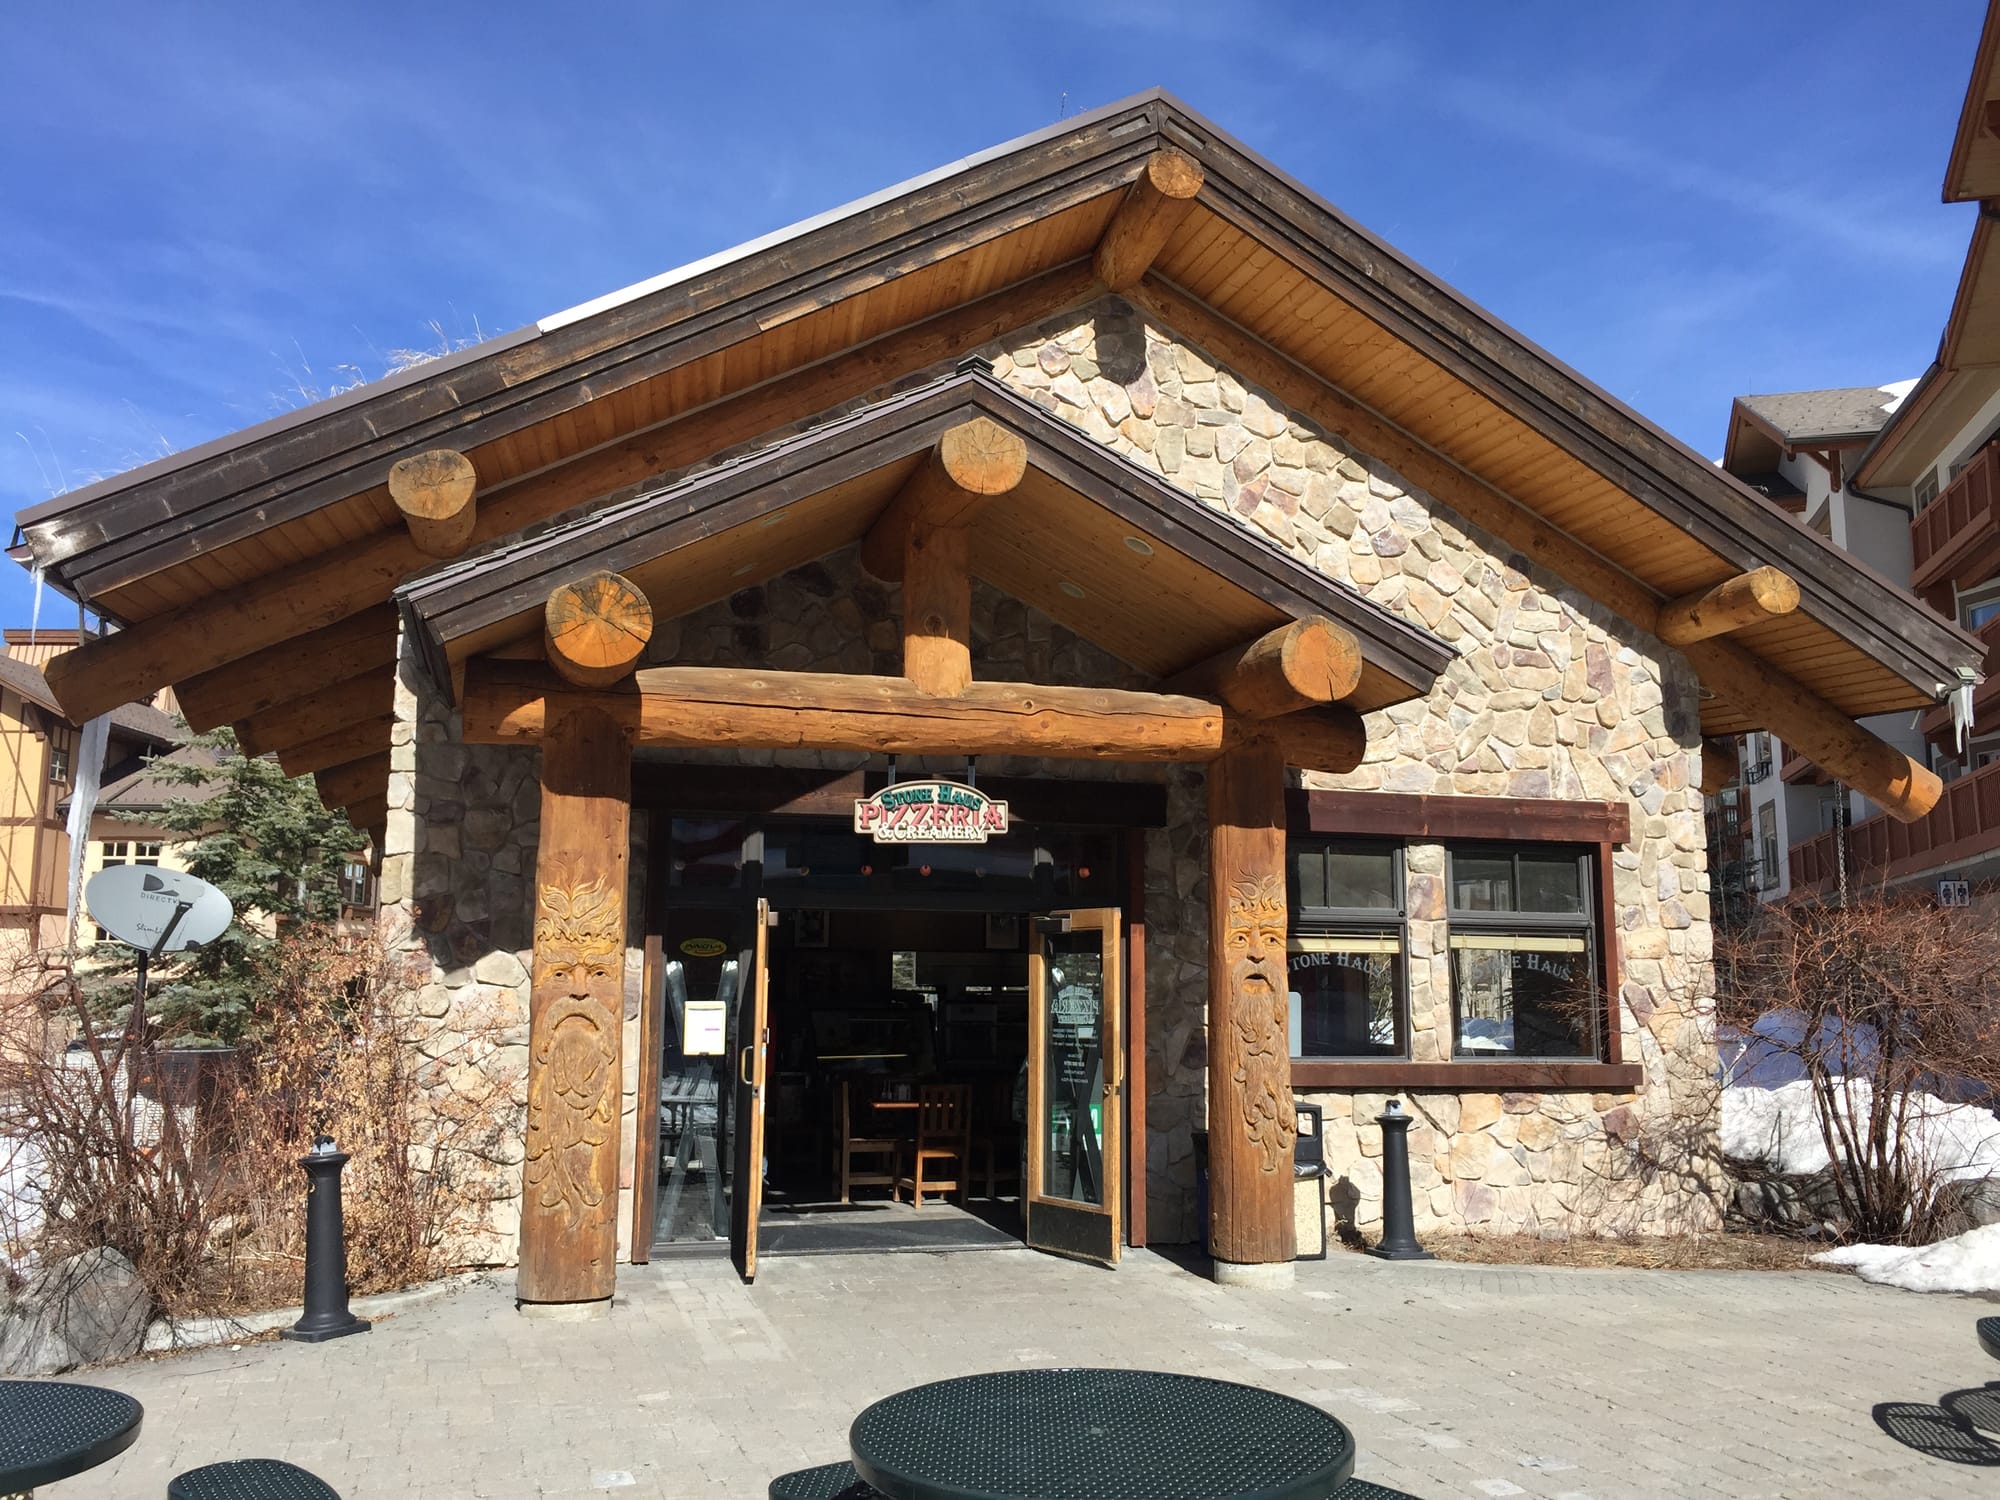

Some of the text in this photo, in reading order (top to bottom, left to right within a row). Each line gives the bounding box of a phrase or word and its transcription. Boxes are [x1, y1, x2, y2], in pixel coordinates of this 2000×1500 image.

[881, 784, 983, 811] STONE HAUS
[859, 803, 1007, 831] PIZZERIA
[1287, 952, 1331, 974] TONE
[1527, 953, 1572, 982] HAUS
